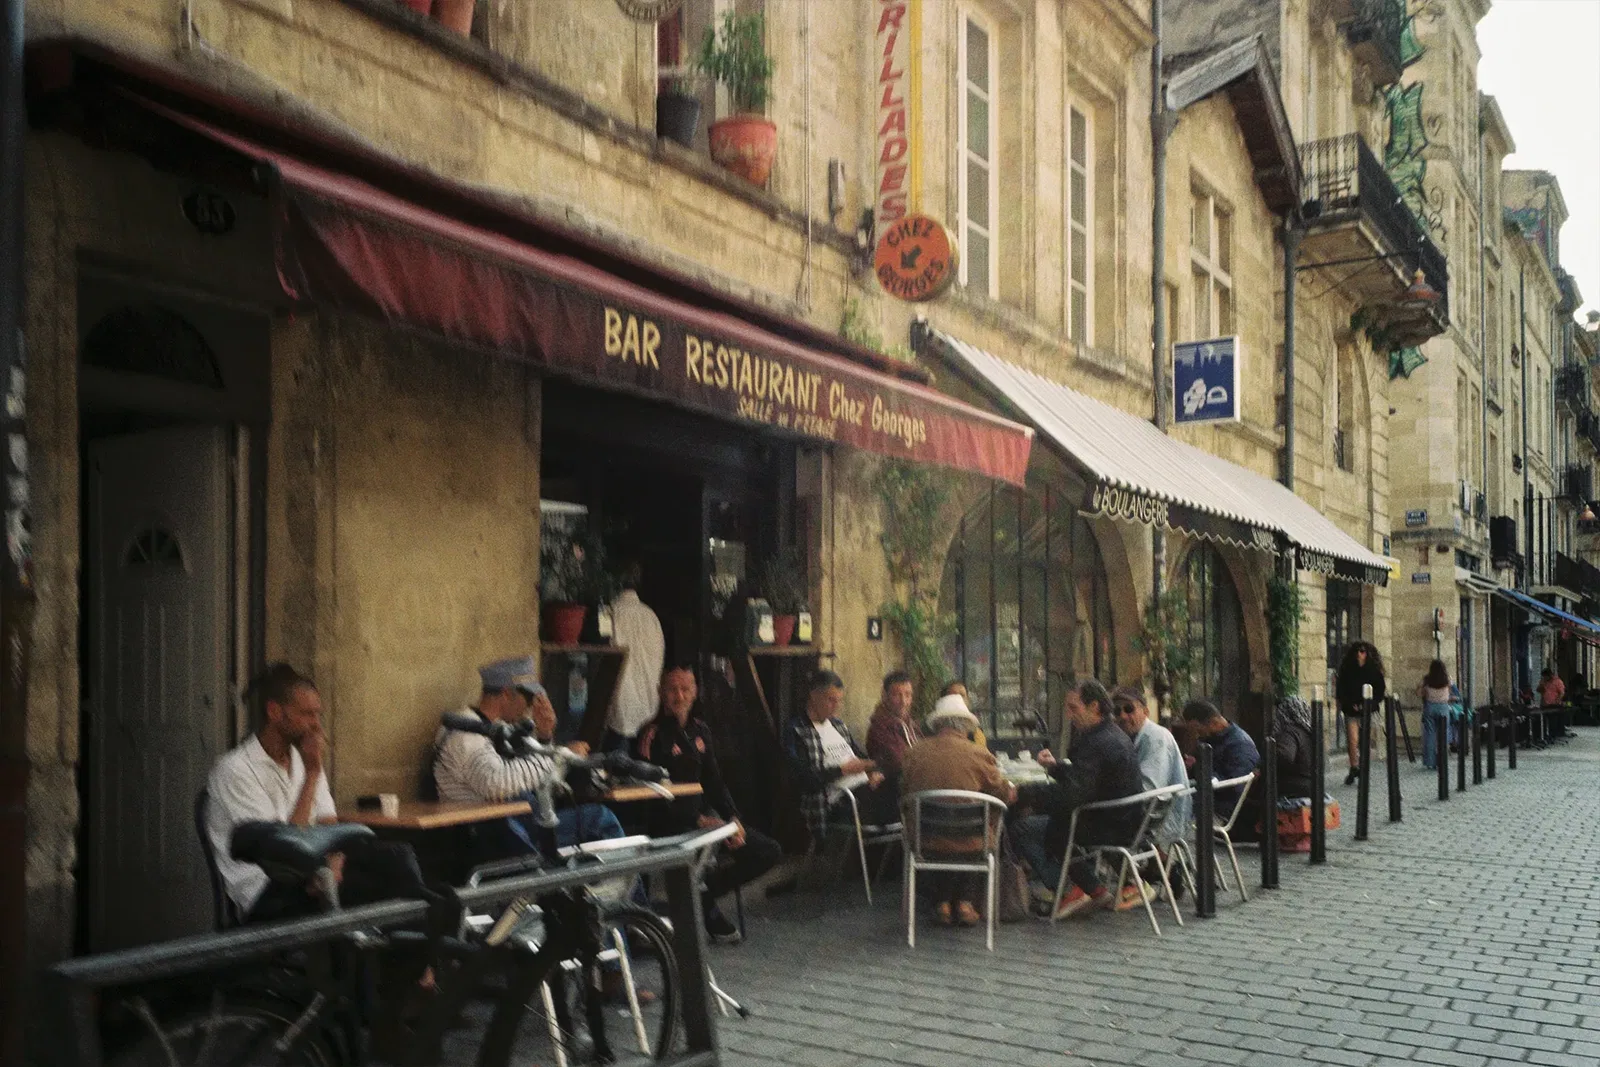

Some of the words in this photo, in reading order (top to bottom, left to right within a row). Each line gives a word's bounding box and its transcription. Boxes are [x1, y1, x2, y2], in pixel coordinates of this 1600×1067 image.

[876, 0, 907, 221] RILLADES
[886, 218, 935, 247] CHEZ
[604, 306, 661, 371] BAR
[686, 333, 822, 414] RESTAURANT
[829, 379, 865, 427] Chez
[871, 393, 926, 449] Georges
[1101, 485, 1169, 526] BOULANGERIE
